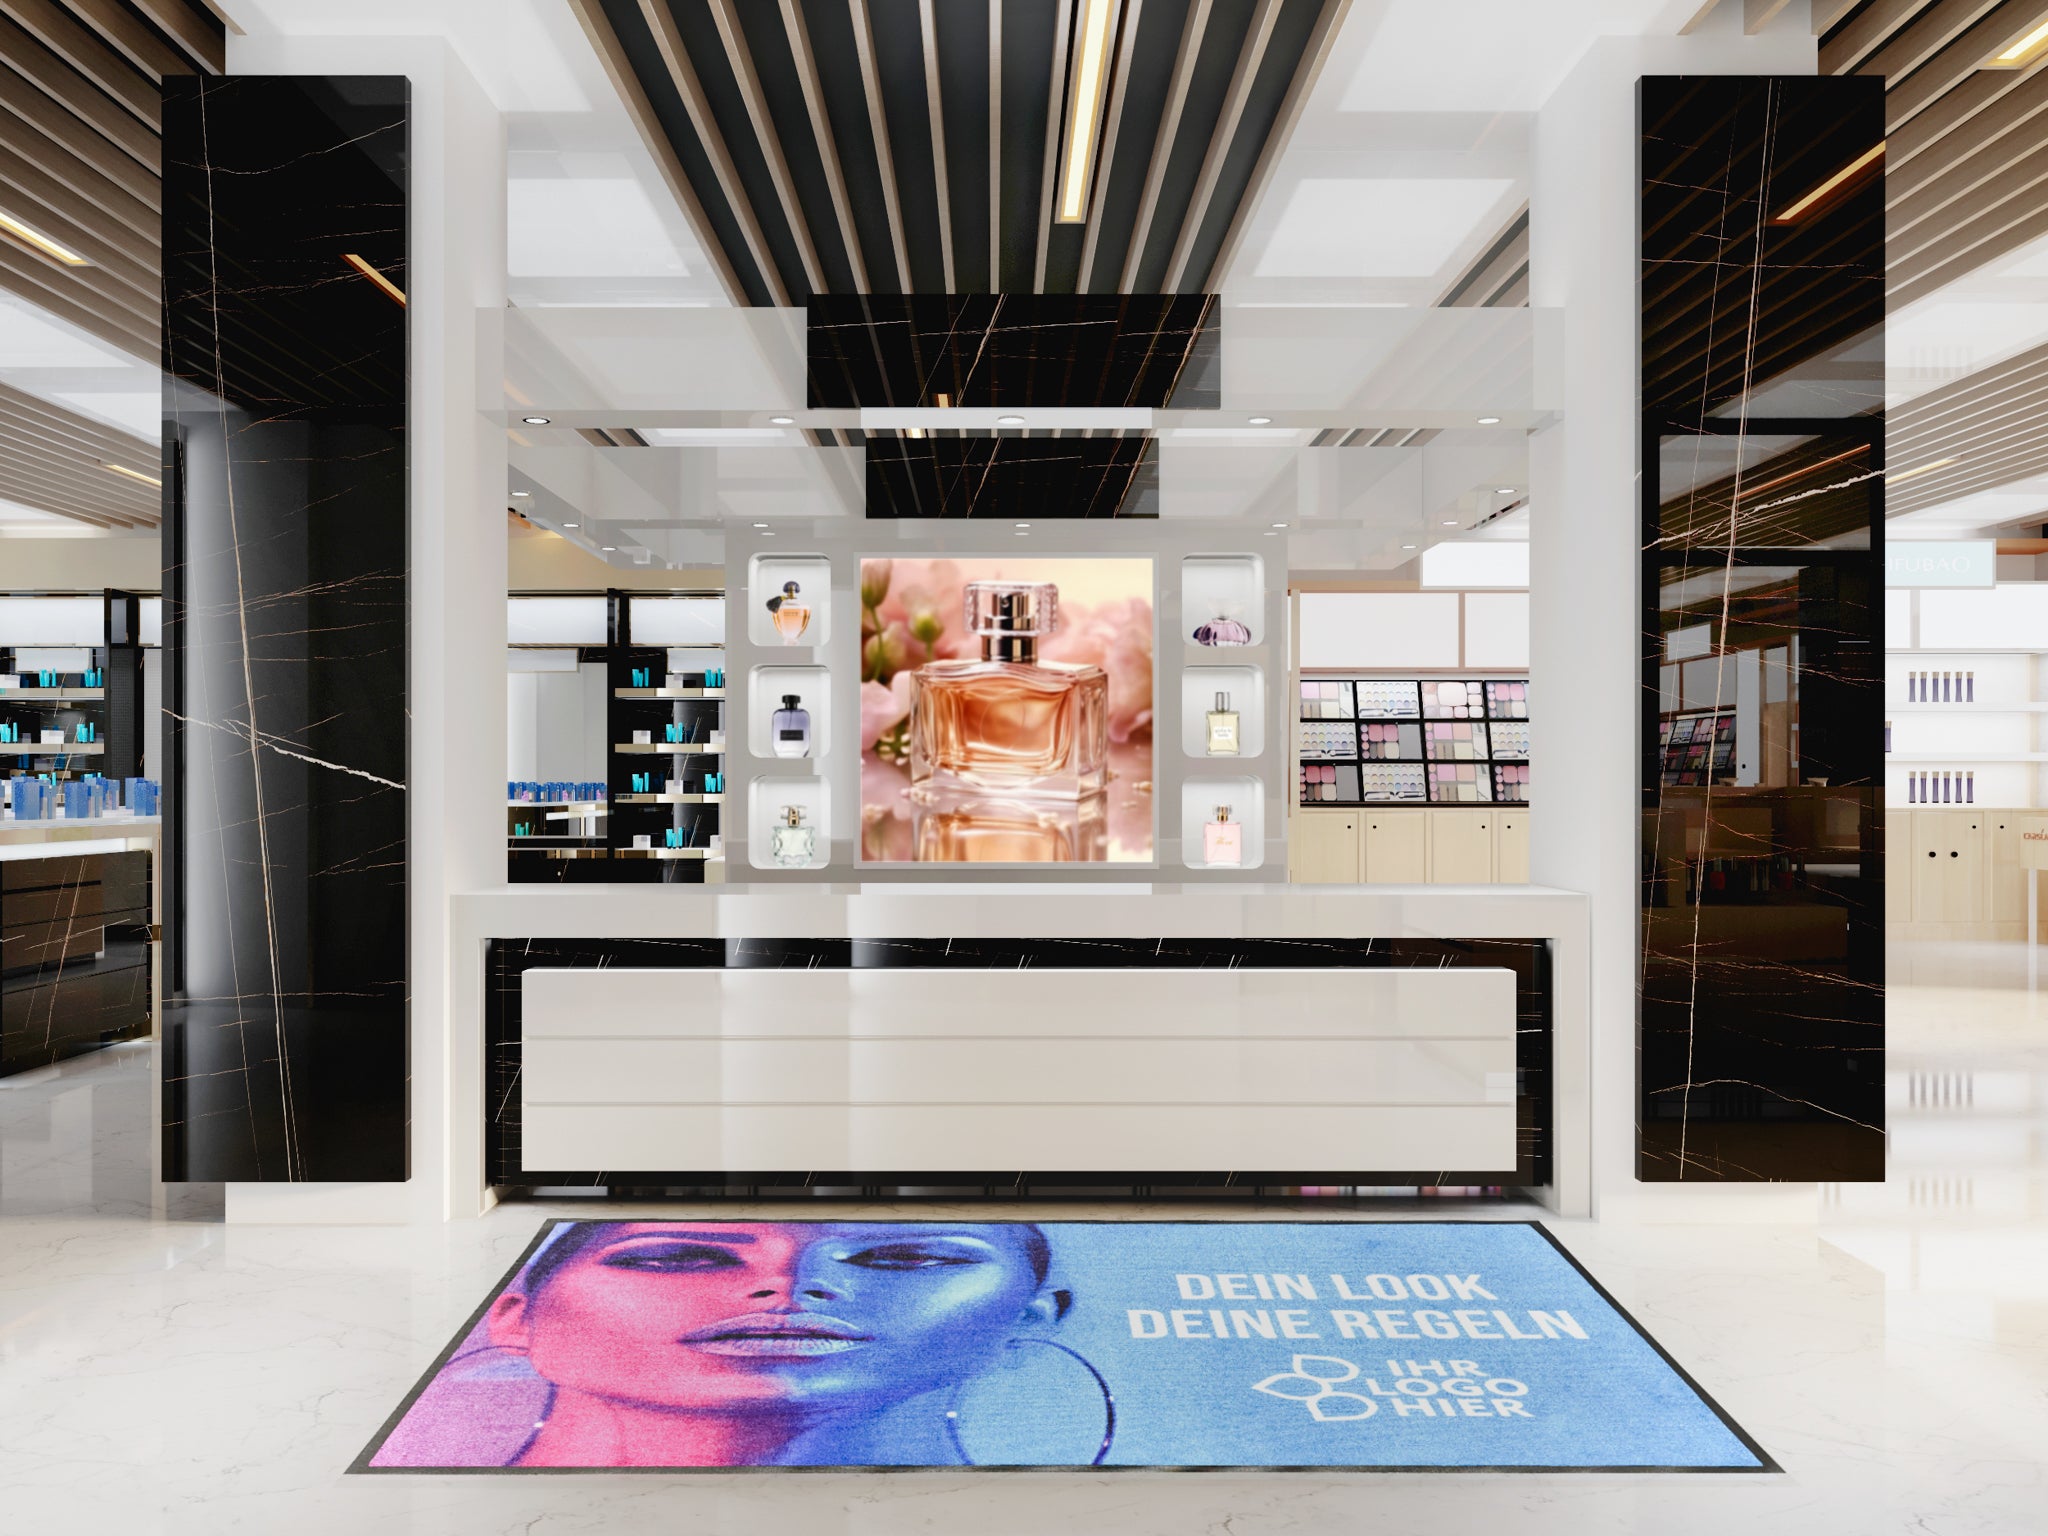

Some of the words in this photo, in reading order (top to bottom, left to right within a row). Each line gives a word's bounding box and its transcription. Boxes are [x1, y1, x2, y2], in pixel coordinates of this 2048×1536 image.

[1175, 1274, 1318, 1300] DEIN
[1331, 1274, 1498, 1301] LOOK
[1127, 1309, 1320, 1340] DEINE
[1330, 1309, 1590, 1340] REGELN
[1387, 1360, 1491, 1378] IHR
[1370, 1377, 1530, 1398] LOGO
[1391, 1398, 1535, 1418] HIER
